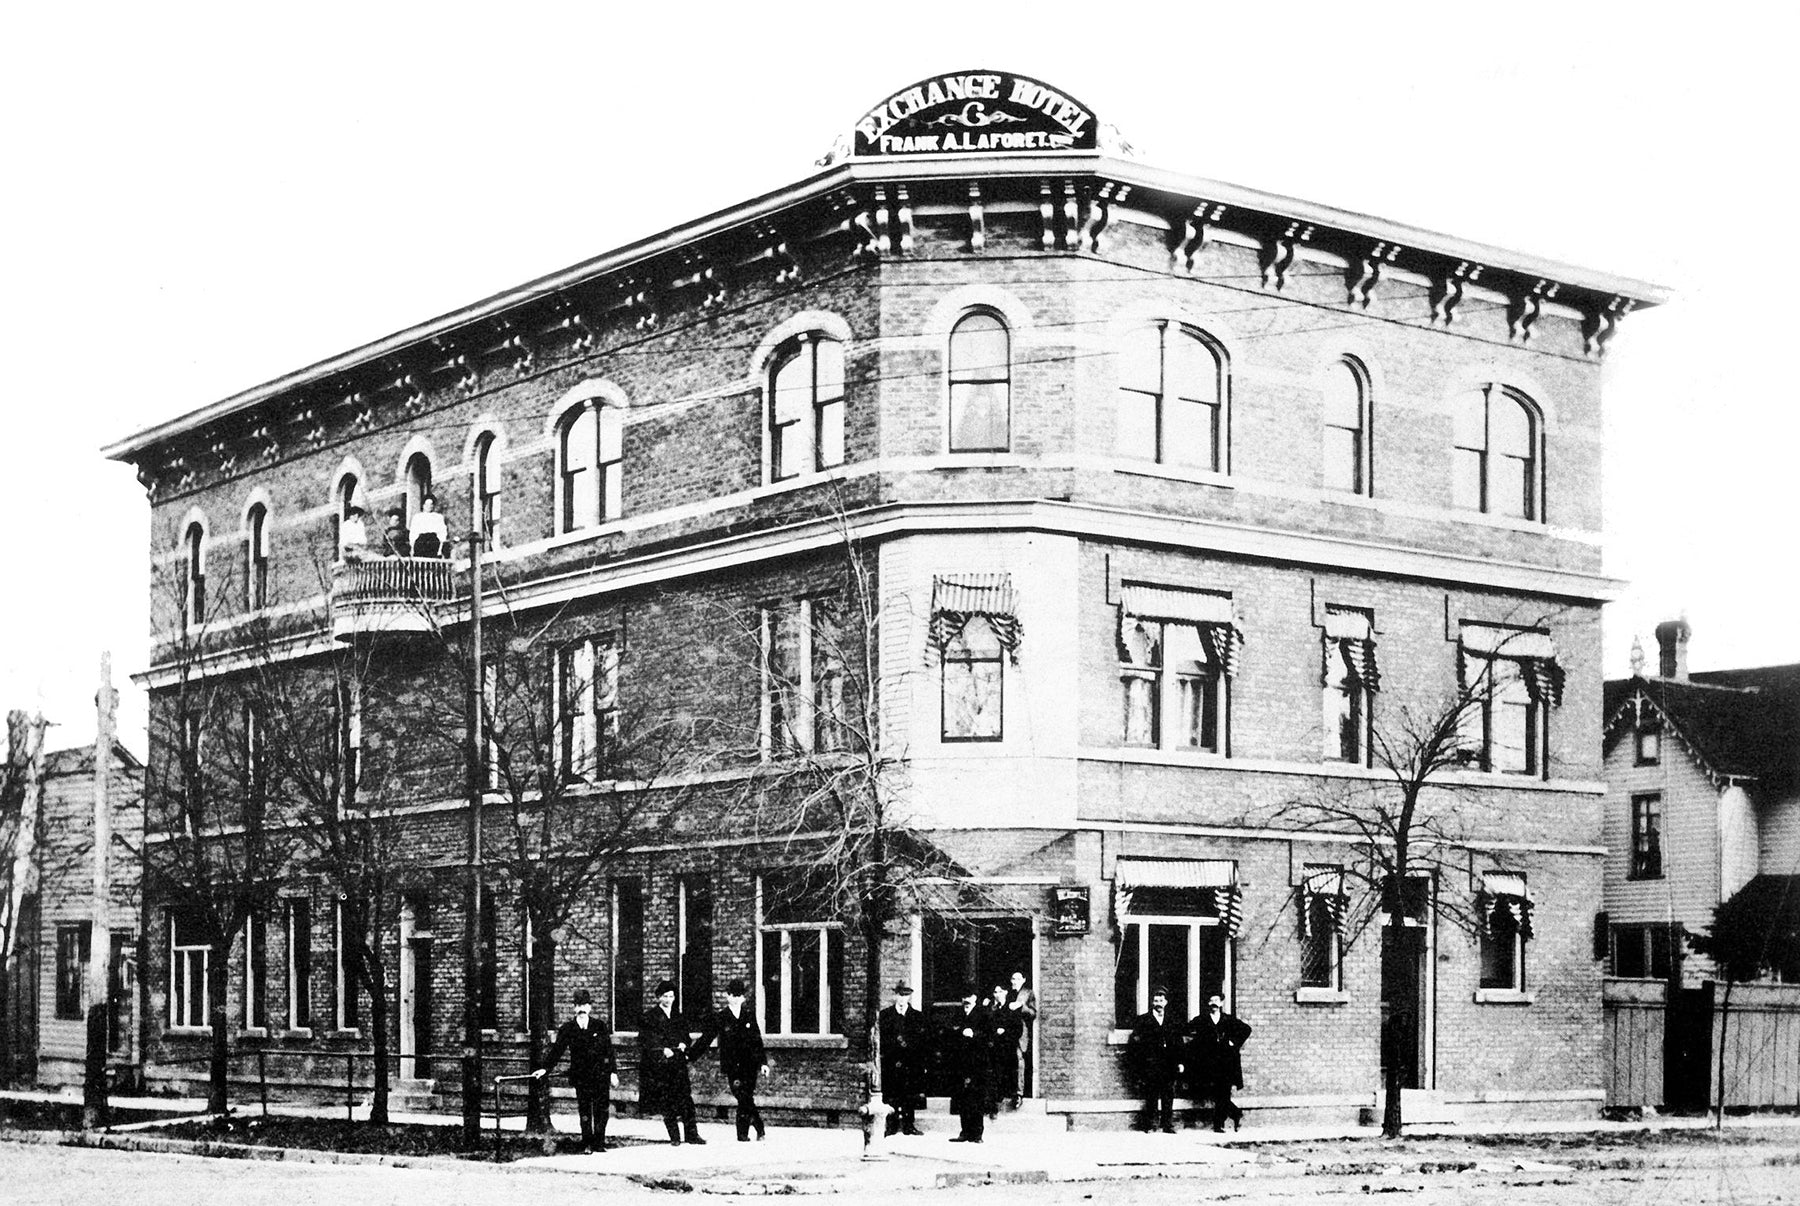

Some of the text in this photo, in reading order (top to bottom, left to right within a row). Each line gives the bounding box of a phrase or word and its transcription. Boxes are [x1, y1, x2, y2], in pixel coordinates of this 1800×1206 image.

[856, 75, 1092, 145] EXCHANGE HOTEL
[880, 134, 940, 152] FRANK
